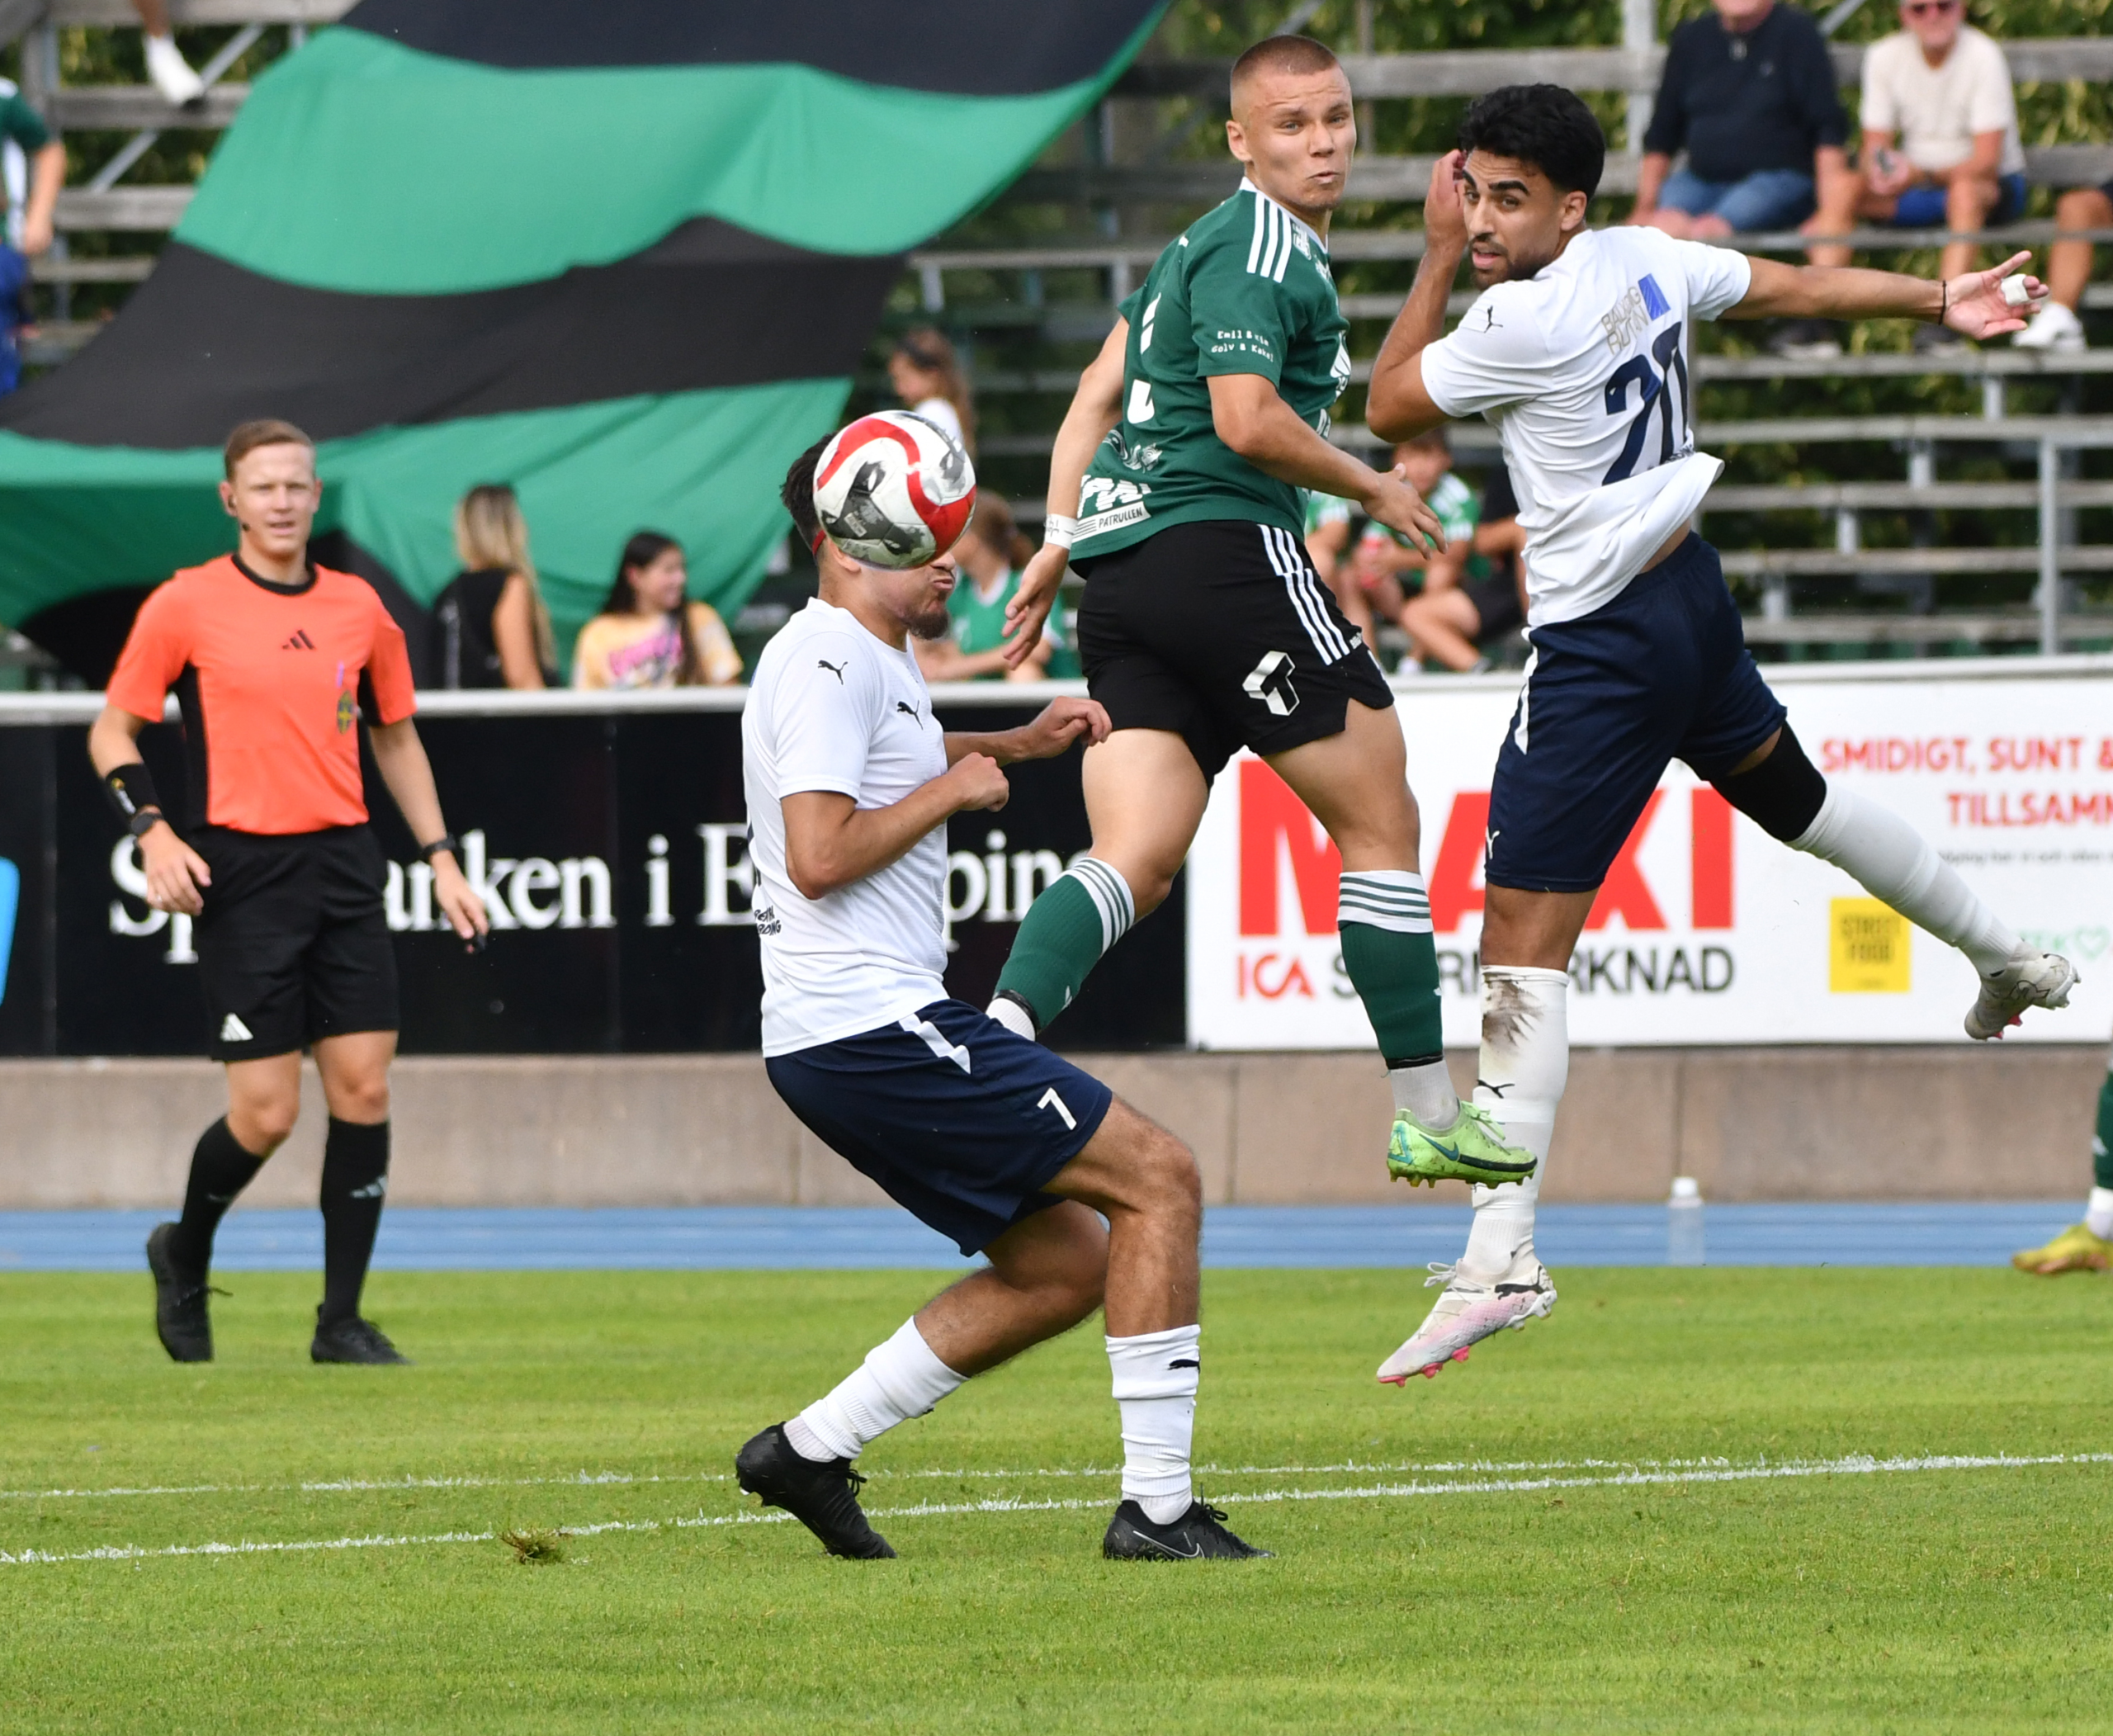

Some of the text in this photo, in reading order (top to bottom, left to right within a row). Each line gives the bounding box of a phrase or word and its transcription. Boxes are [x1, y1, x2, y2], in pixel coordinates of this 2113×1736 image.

[1211, 343, 1235, 352] Golv
[1217, 329, 1242, 339] Emil
[1601, 321, 1688, 486] 20
[1099, 507, 1143, 529] PATRULLEN
[1822, 737, 1977, 777] SMIDIGT,
[1988, 737, 2082, 772] SUNT
[1947, 793, 2113, 826] TILLSAM
[643, 834, 675, 927] i
[1237, 953, 1314, 998] ICA
[1036, 1086, 1078, 1131] 7
